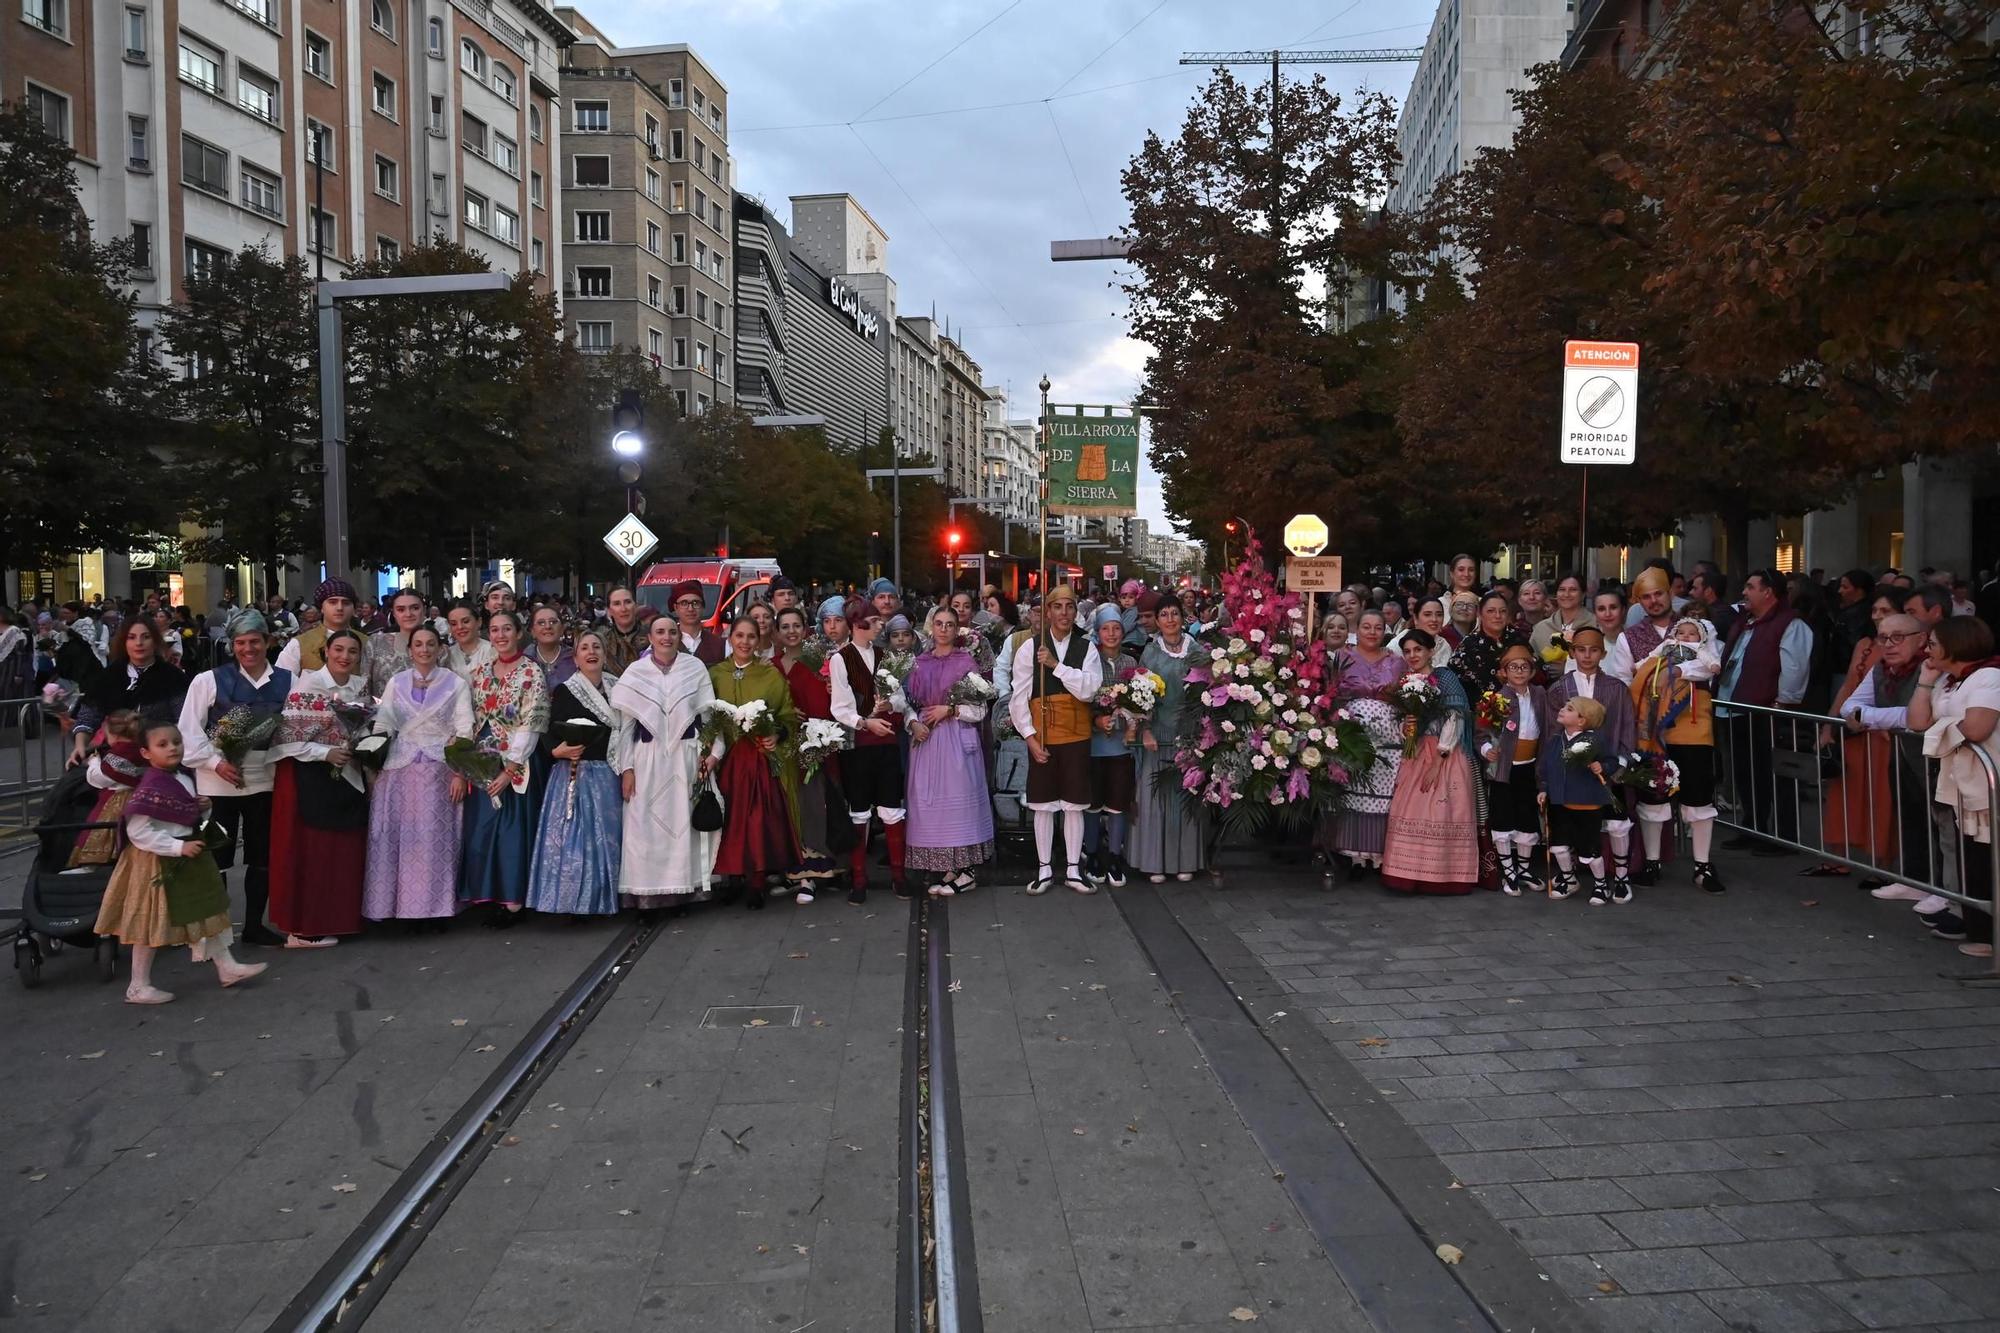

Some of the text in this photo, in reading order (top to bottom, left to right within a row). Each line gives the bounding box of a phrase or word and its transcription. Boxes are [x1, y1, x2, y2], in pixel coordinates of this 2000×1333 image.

[830, 276, 840, 306] El
[840, 286, 857, 319] Corte
[1574, 350, 1630, 361] ATENCIÓN
[1049, 423, 1138, 437] VILLARROYA
[1570, 433, 1628, 443] PRIORIDAD
[1052, 449, 1073, 462] DE
[1570, 447, 1627, 456] PEATONAL
[1111, 460, 1131, 473] LA
[1067, 485, 1118, 499] SIERRA
[619, 530, 643, 548] 30
